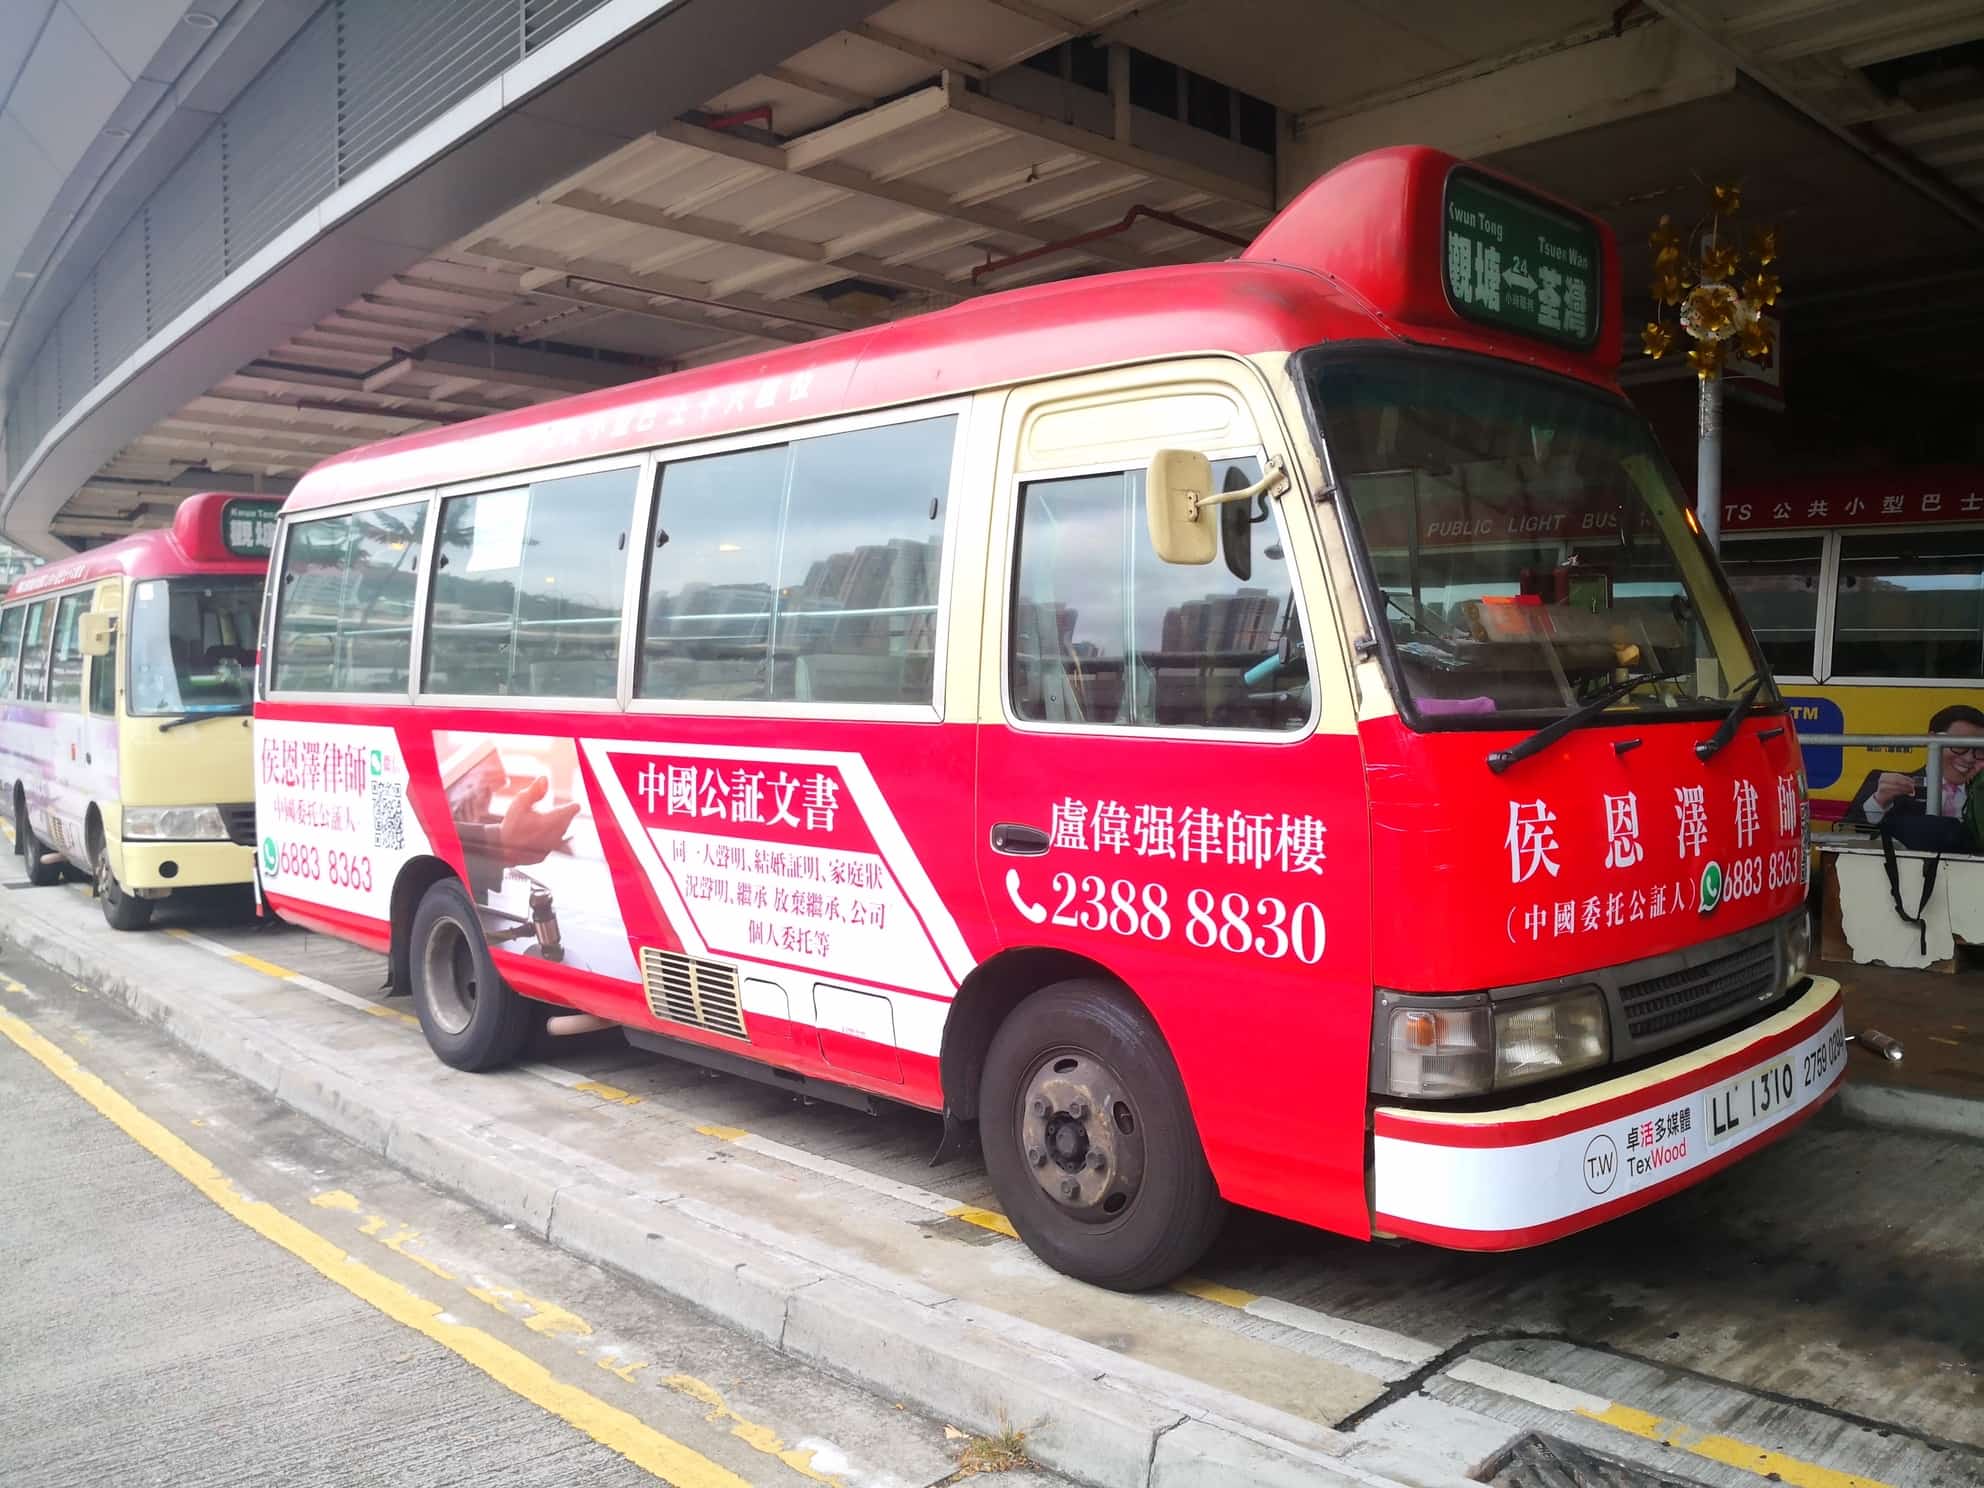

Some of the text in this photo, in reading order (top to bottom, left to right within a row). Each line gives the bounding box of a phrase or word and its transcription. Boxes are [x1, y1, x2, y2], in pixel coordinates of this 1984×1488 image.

[1478, 212, 1503, 242] Tong
[1513, 256, 1528, 275] 24
[1427, 511, 1617, 537] PUBLIC LIGHT BUS
[1724, 504, 1752, 521] TS
[1772, 493, 1984, 520] 公共小型巴士
[1791, 706, 1818, 720] TM
[261, 737, 366, 797] 侯恩澤律師
[637, 761, 840, 833] 中國公証文書
[1504, 774, 1797, 884] 侯恩澤律師
[281, 842, 373, 893] 6883 8363
[1723, 847, 1798, 902] 6883 8363
[1051, 871, 1327, 965] 2388 8830
[1803, 1042, 1827, 1087] 2759
[1711, 1063, 1793, 1136] LL 1310
[1626, 1107, 1692, 1152] 卓活多媒體
[1627, 1136, 1687, 1177] TexWood
